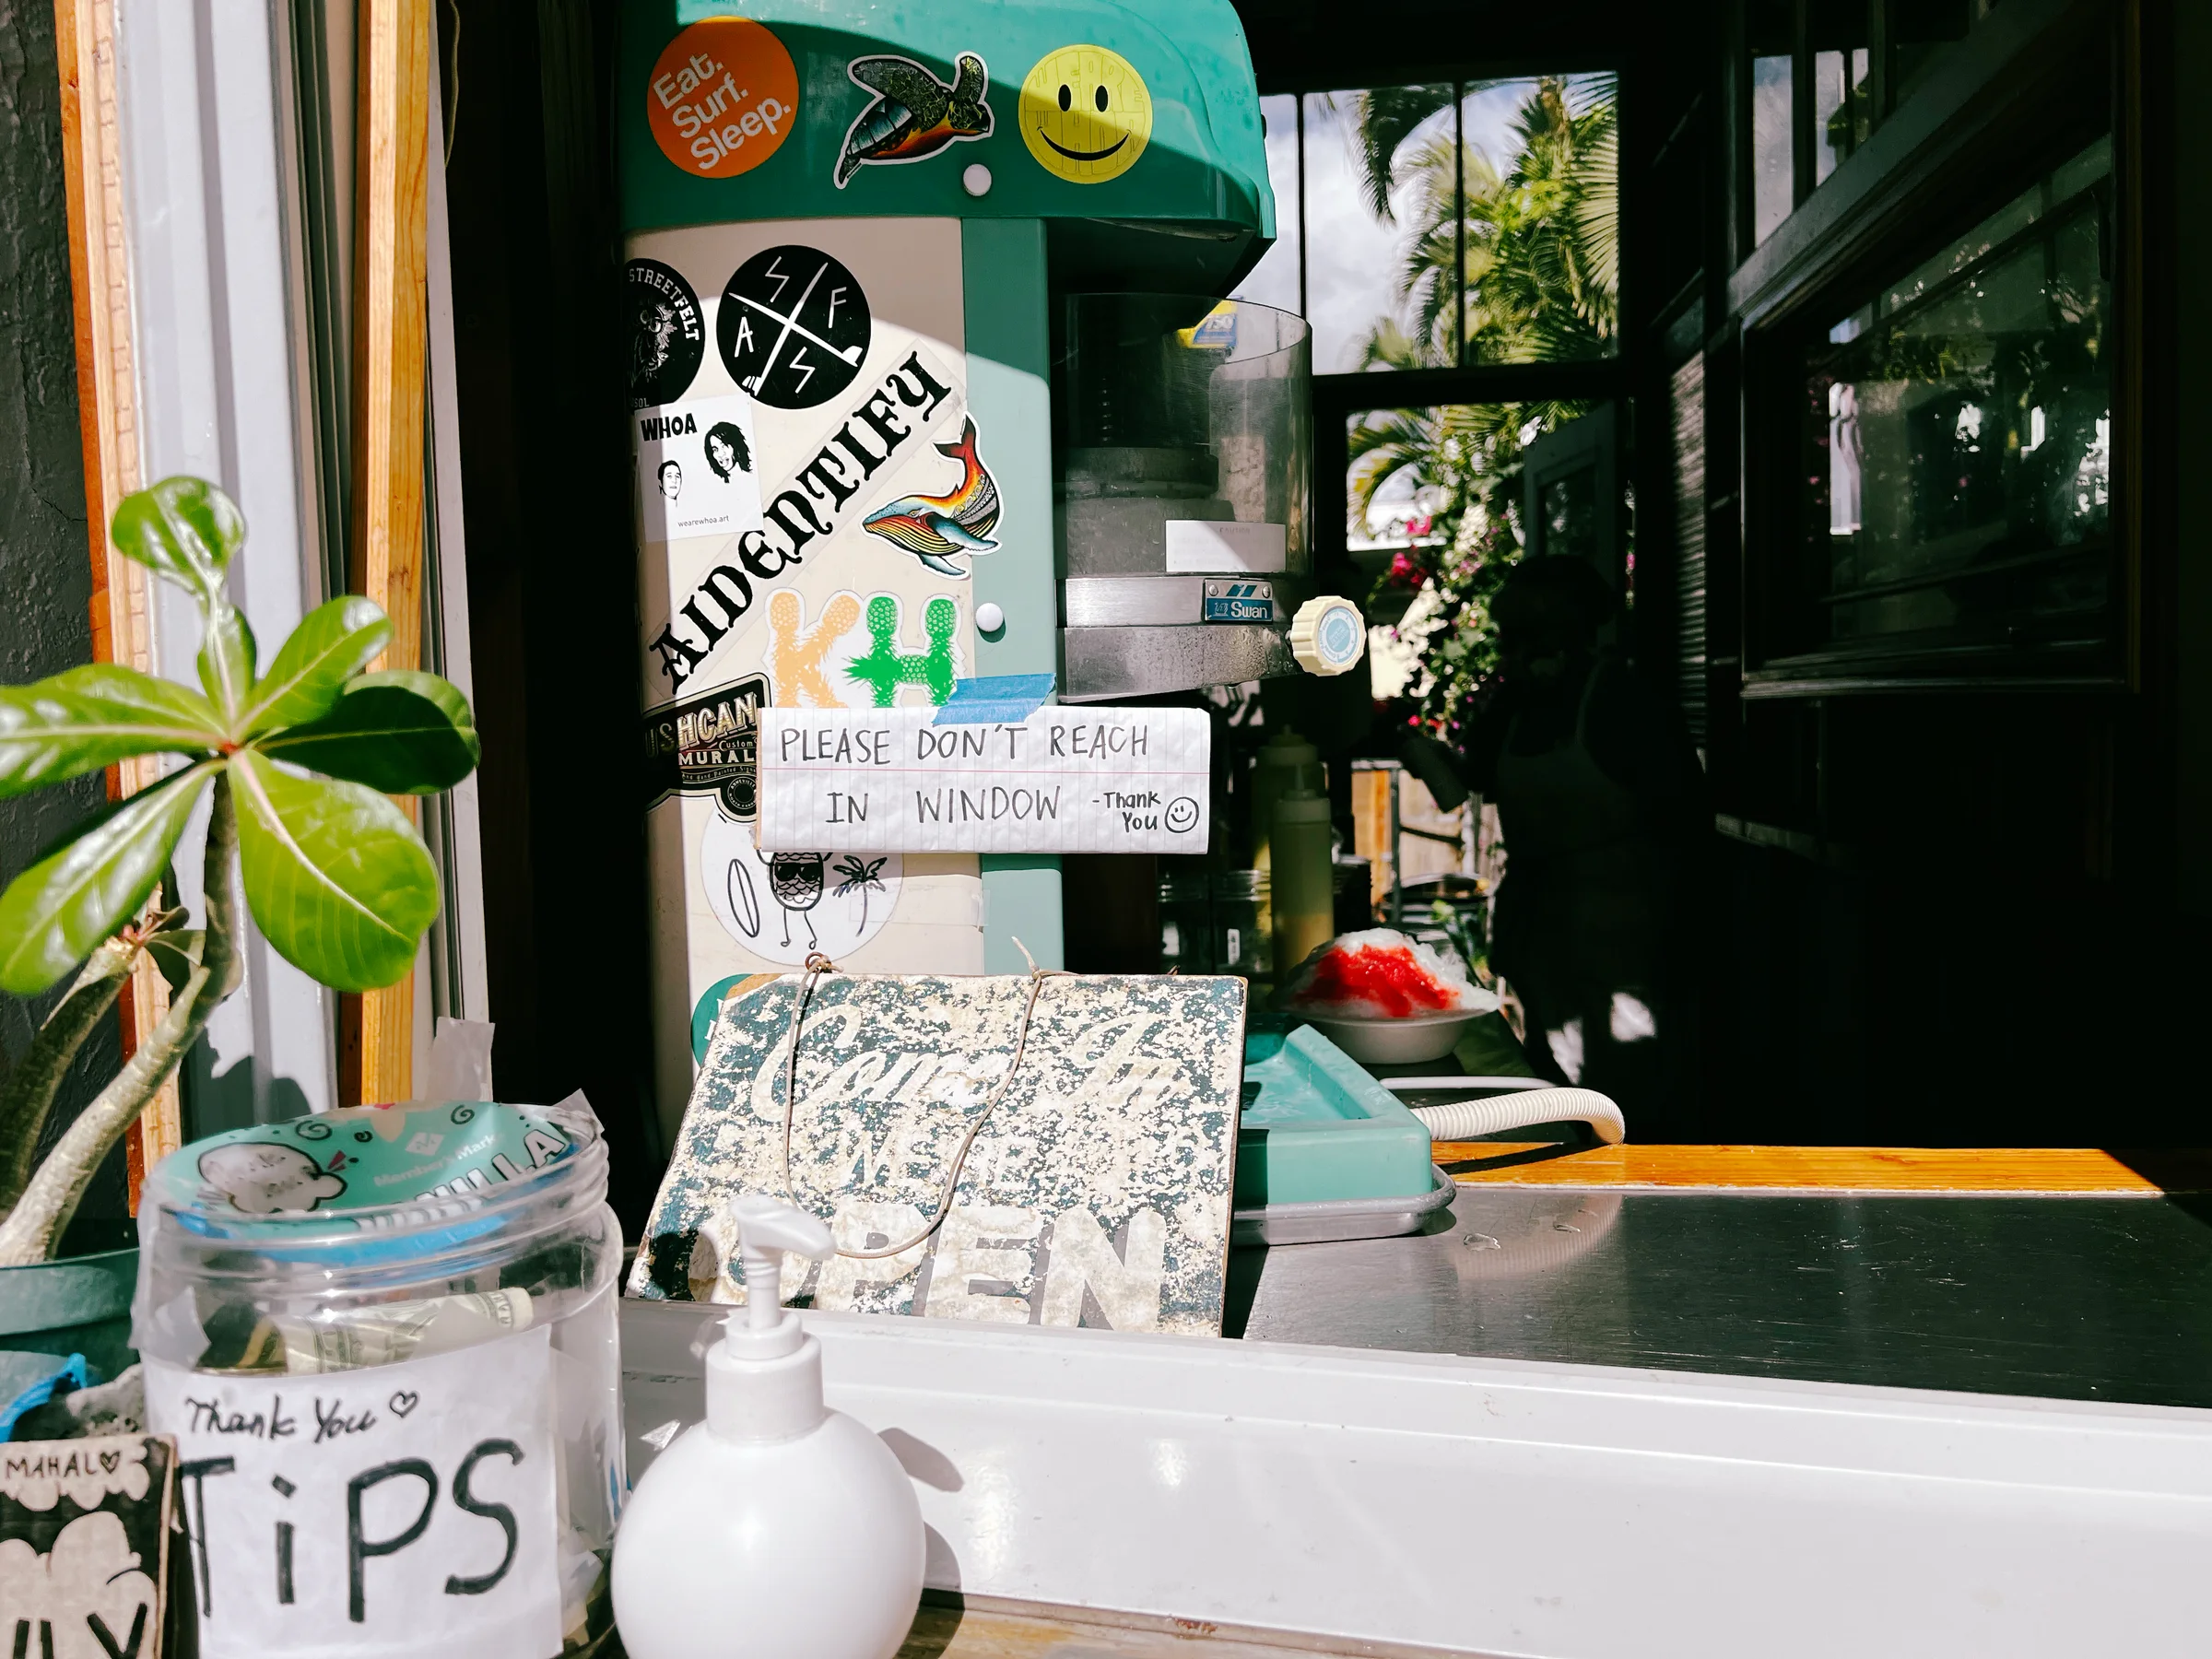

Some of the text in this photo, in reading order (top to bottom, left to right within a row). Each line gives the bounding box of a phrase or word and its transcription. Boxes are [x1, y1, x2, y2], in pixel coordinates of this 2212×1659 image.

[653, 53, 724, 110] Eat.
[672, 71, 749, 139] Surf.
[690, 98, 792, 170] Sleep.
[641, 412, 698, 441] WHOA
[649, 350, 952, 695] AIDENTIFY
[677, 514, 730, 528] wearewhoa.art
[1230, 601, 1268, 618] Swan
[645, 691, 758, 759] USHCAN
[780, 724, 1148, 765] PLEASE DON'T REACH
[678, 748, 757, 766] MURAL
[826, 785, 1062, 824] IN WINDOW
[1123, 811, 1158, 833] You
[457, 1133, 497, 1160] Mark
[184, 1394, 377, 1444] Thank You
